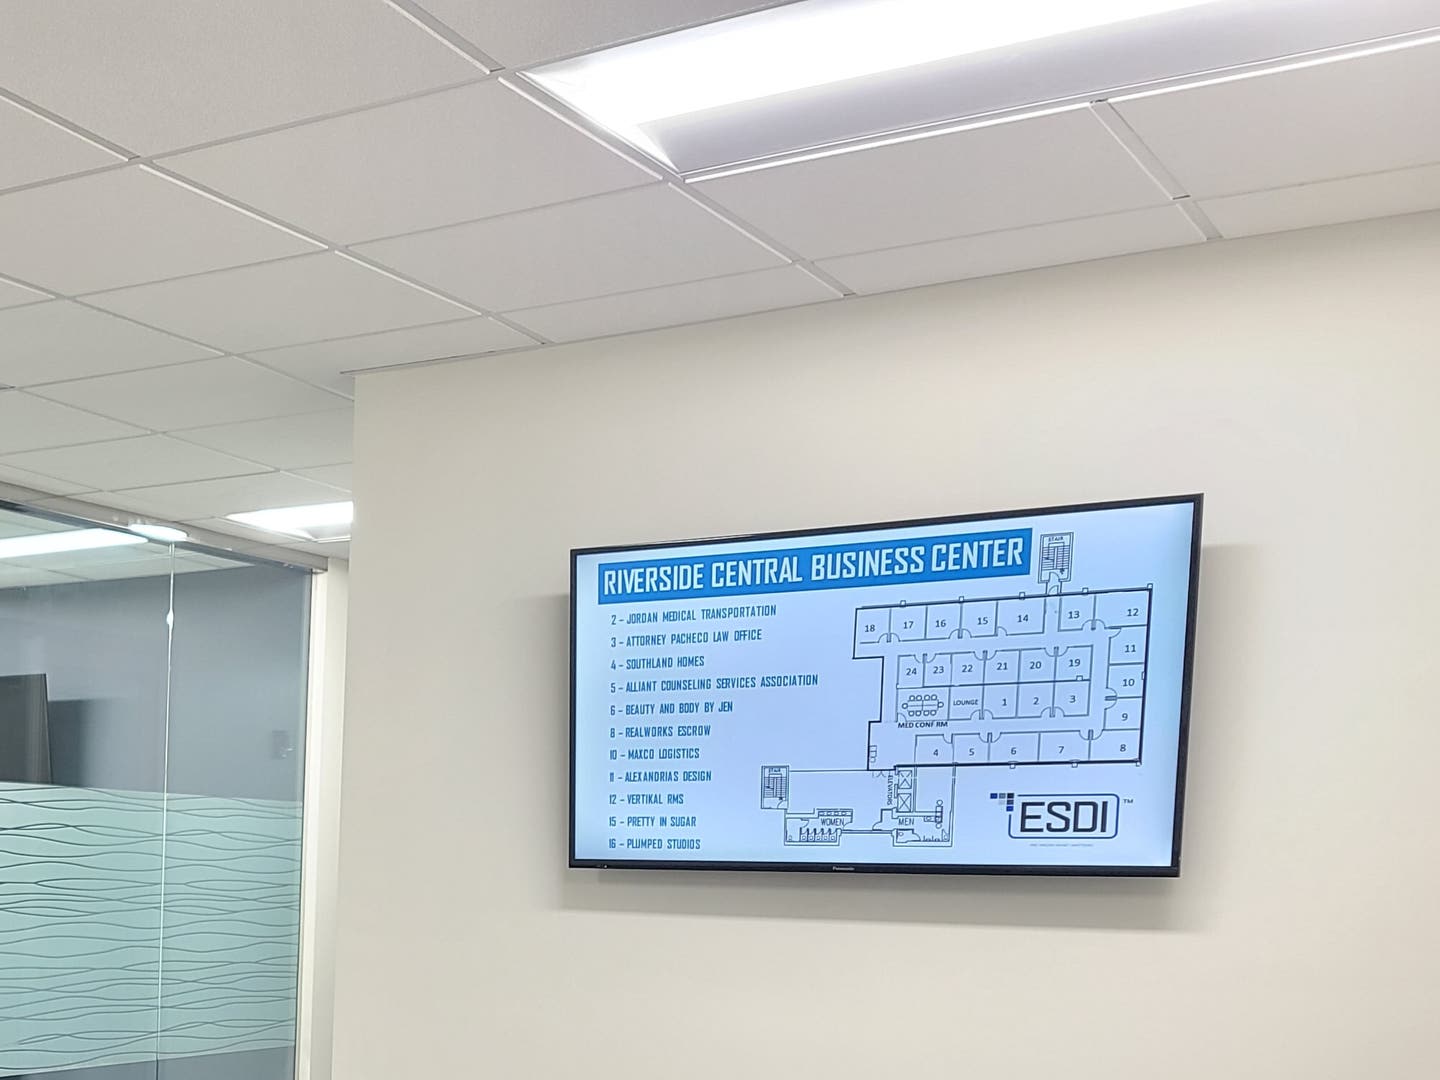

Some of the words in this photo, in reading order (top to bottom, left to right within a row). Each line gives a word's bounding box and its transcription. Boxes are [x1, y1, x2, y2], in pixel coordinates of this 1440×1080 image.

[603, 563, 704, 595] RIVERSIDE
[711, 556, 803, 588] CENTRAL
[810, 546, 925, 581] BUSINESS
[931, 537, 1024, 572] CENTER
[611, 614, 617, 625] 2
[626, 612, 658, 624] JORDAN
[662, 610, 696, 622] MEDICAL
[701, 605, 777, 620] TRANSPORTATION
[1068, 610, 1080, 619] 13
[1127, 608, 1139, 617] 12
[977, 616, 989, 625] 15
[1017, 614, 1029, 623] 14
[903, 621, 914, 629] 17
[935, 619, 947, 628] 16
[864, 624, 876, 633] 18
[611, 637, 617, 648] 3
[626, 634, 666, 647] ATTORNEY
[671, 631, 709, 645] PACHECO
[713, 631, 729, 642] LAW
[734, 629, 762, 641] OFFICE
[1124, 644, 1136, 653] 11
[610, 659, 616, 670] 4
[626, 657, 673, 670] SOUTHLAND
[677, 655, 705, 668] HOMES
[996, 662, 1008, 671] 21
[1029, 661, 1042, 670] 20
[1068, 659, 1081, 667] 19
[906, 667, 917, 676] 24
[933, 666, 944, 674] 23
[962, 664, 973, 673] 22
[610, 682, 616, 693] 5
[626, 680, 657, 692] ALLIANT
[661, 678, 712, 691] COUNSELING
[716, 676, 756, 689] SERVICES
[760, 674, 818, 687] ASSOCIATION
[1122, 678, 1135, 687] 10
[1001, 698, 1007, 706] 1
[1033, 697, 1039, 705] 2
[1069, 695, 1076, 704] 3
[610, 705, 616, 716] 6
[625, 704, 655, 715] BEAUTY
[659, 703, 675, 714] AND
[679, 702, 700, 713] BODY
[704, 701, 715, 713] BY
[718, 701, 733, 712] JEN
[1121, 713, 1128, 721] 9
[610, 727, 616, 738] 8
[625, 726, 673, 738] REALWORKS
[677, 725, 711, 737] ESCROW
[969, 748, 975, 756] 5
[1010, 747, 1017, 755] 6
[1058, 746, 1065, 754] 7
[1120, 744, 1127, 752] 8
[610, 749, 617, 760] 10
[628, 749, 655, 760] MAXCO
[659, 748, 700, 759] LOGISTICS
[625, 771, 679, 782] ALEXANDRIAS
[682, 770, 712, 782] DESIGN
[609, 794, 617, 804] 12
[627, 794, 663, 805] VERTIKAL
[667, 794, 684, 804] RMS
[1020, 800, 1109, 833] ESDI
[609, 816, 617, 827] 15
[627, 816, 655, 827] PRETTY
[659, 816, 667, 827] IN
[670, 816, 697, 827] SUGAR
[820, 818, 845, 826] WOMEN
[898, 817, 915, 826] MEN
[608, 838, 616, 849] 16
[626, 838, 663, 849] PLUMPED
[667, 838, 701, 850] STUDIOS
